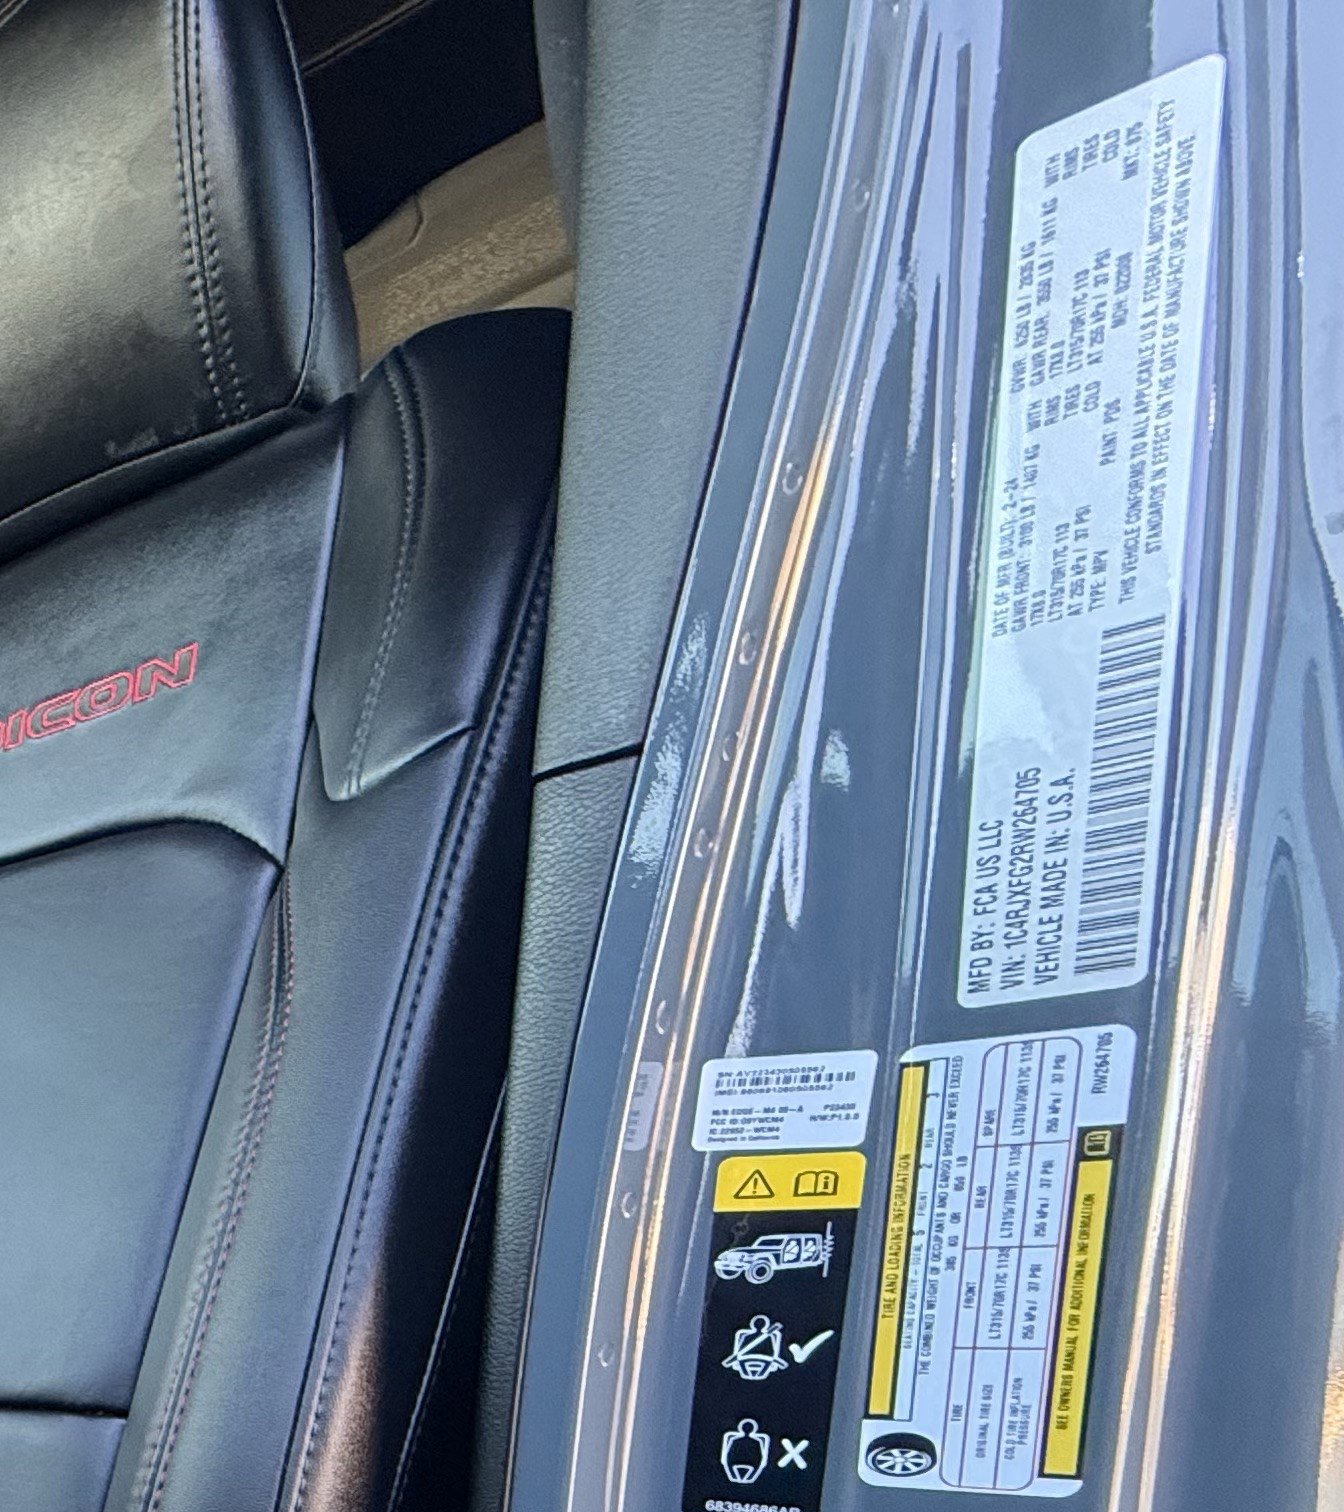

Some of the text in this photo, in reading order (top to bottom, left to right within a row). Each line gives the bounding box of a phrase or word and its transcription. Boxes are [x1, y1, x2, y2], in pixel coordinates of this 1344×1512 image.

[966, 818, 1003, 994] MFD BY: FCA US LLC
[997, 765, 1042, 990] VIN: 1C4RJXFG2RW264705
[1032, 767, 1075, 985] VEHICLE MADE IN: U.S.A.
[1089, 1031, 1114, 1095] RW264705
[881, 1153, 911, 1318] TIRE AND LOADING INFORMATION
[918, 1054, 963, 1375] THE COMBINED WEIGHT OF OCCUPANTS AND CARGO SHOULD NEVER EXCEED
[962, 1280, 977, 1309] FRONT
[1055, 1193, 1095, 1430] SEE OWNERS MANUAL FOR ADDITIONAL INFORMATION
[950, 1403, 963, 1422] TIRE
